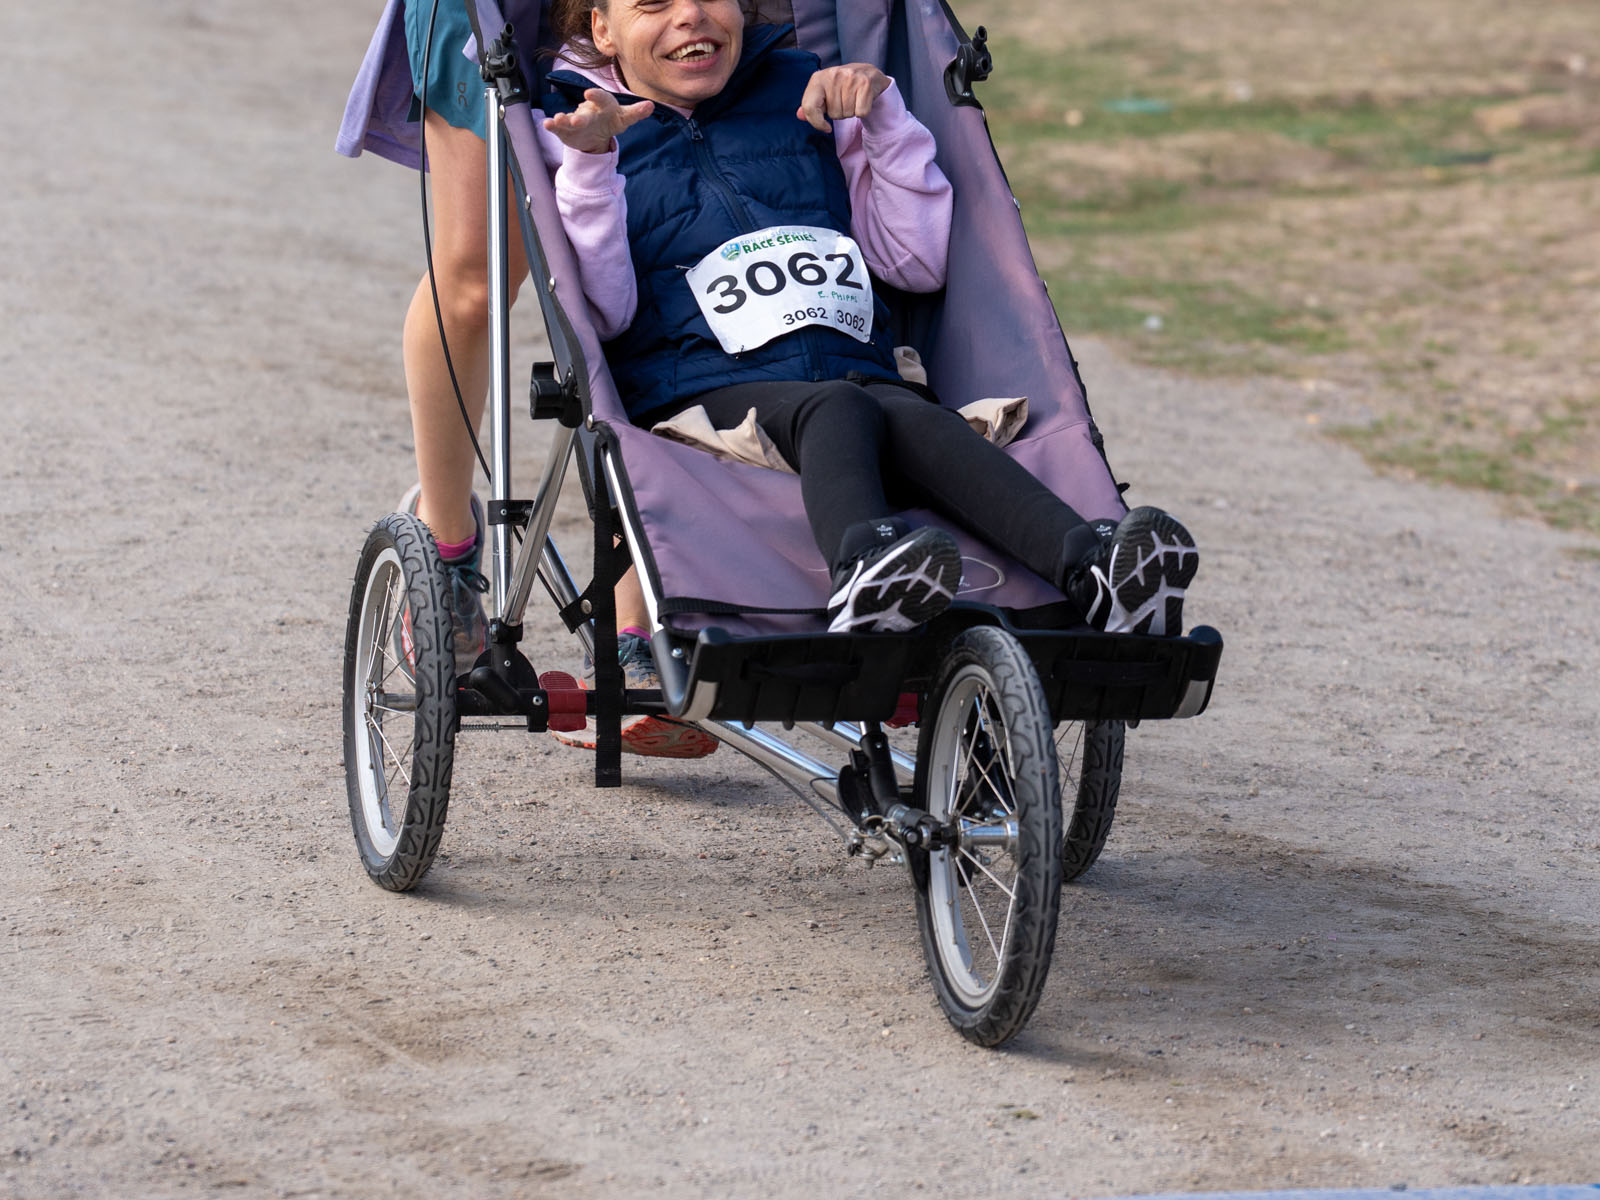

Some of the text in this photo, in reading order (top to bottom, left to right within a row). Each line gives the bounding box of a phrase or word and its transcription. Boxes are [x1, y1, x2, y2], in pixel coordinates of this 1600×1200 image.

[742, 233, 817, 254] RACE SERIES
[706, 252, 864, 314] 3062
[783, 307, 865, 332] 3062 3062
